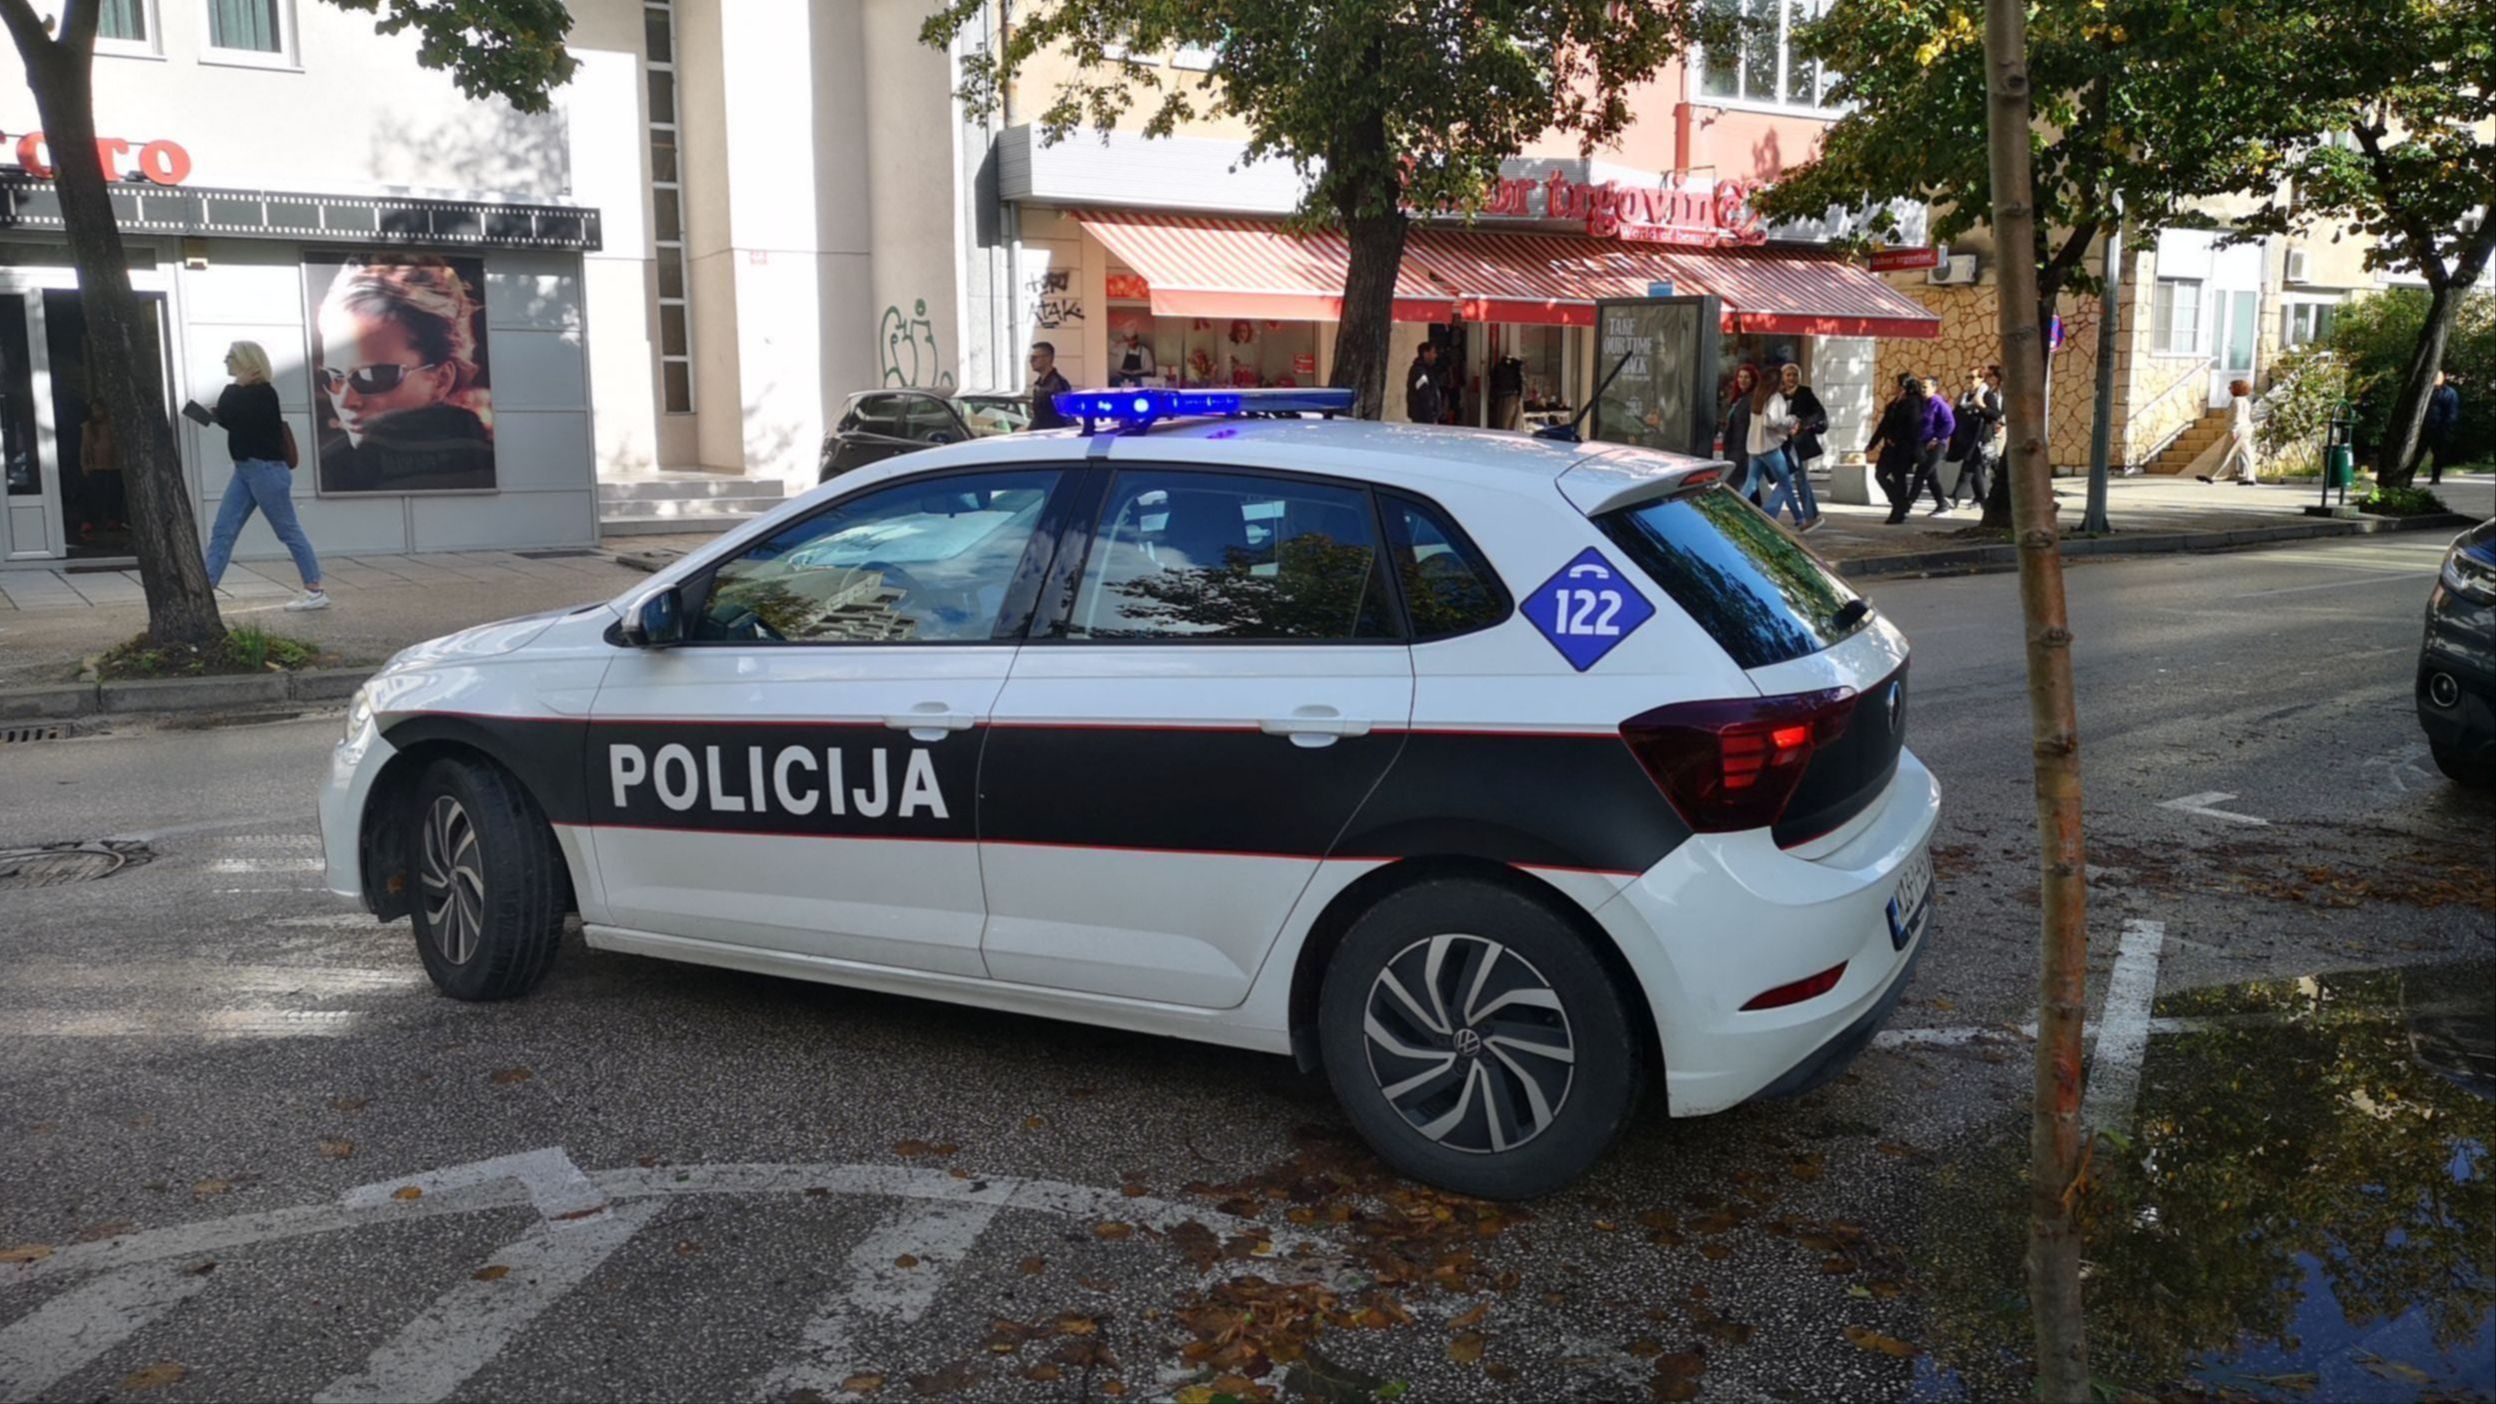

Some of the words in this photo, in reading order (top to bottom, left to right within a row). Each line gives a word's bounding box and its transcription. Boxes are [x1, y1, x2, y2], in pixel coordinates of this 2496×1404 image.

[0, 130, 191, 185] OTO
[1555, 589, 1622, 636] 122
[609, 743, 949, 819] POLICIJA
